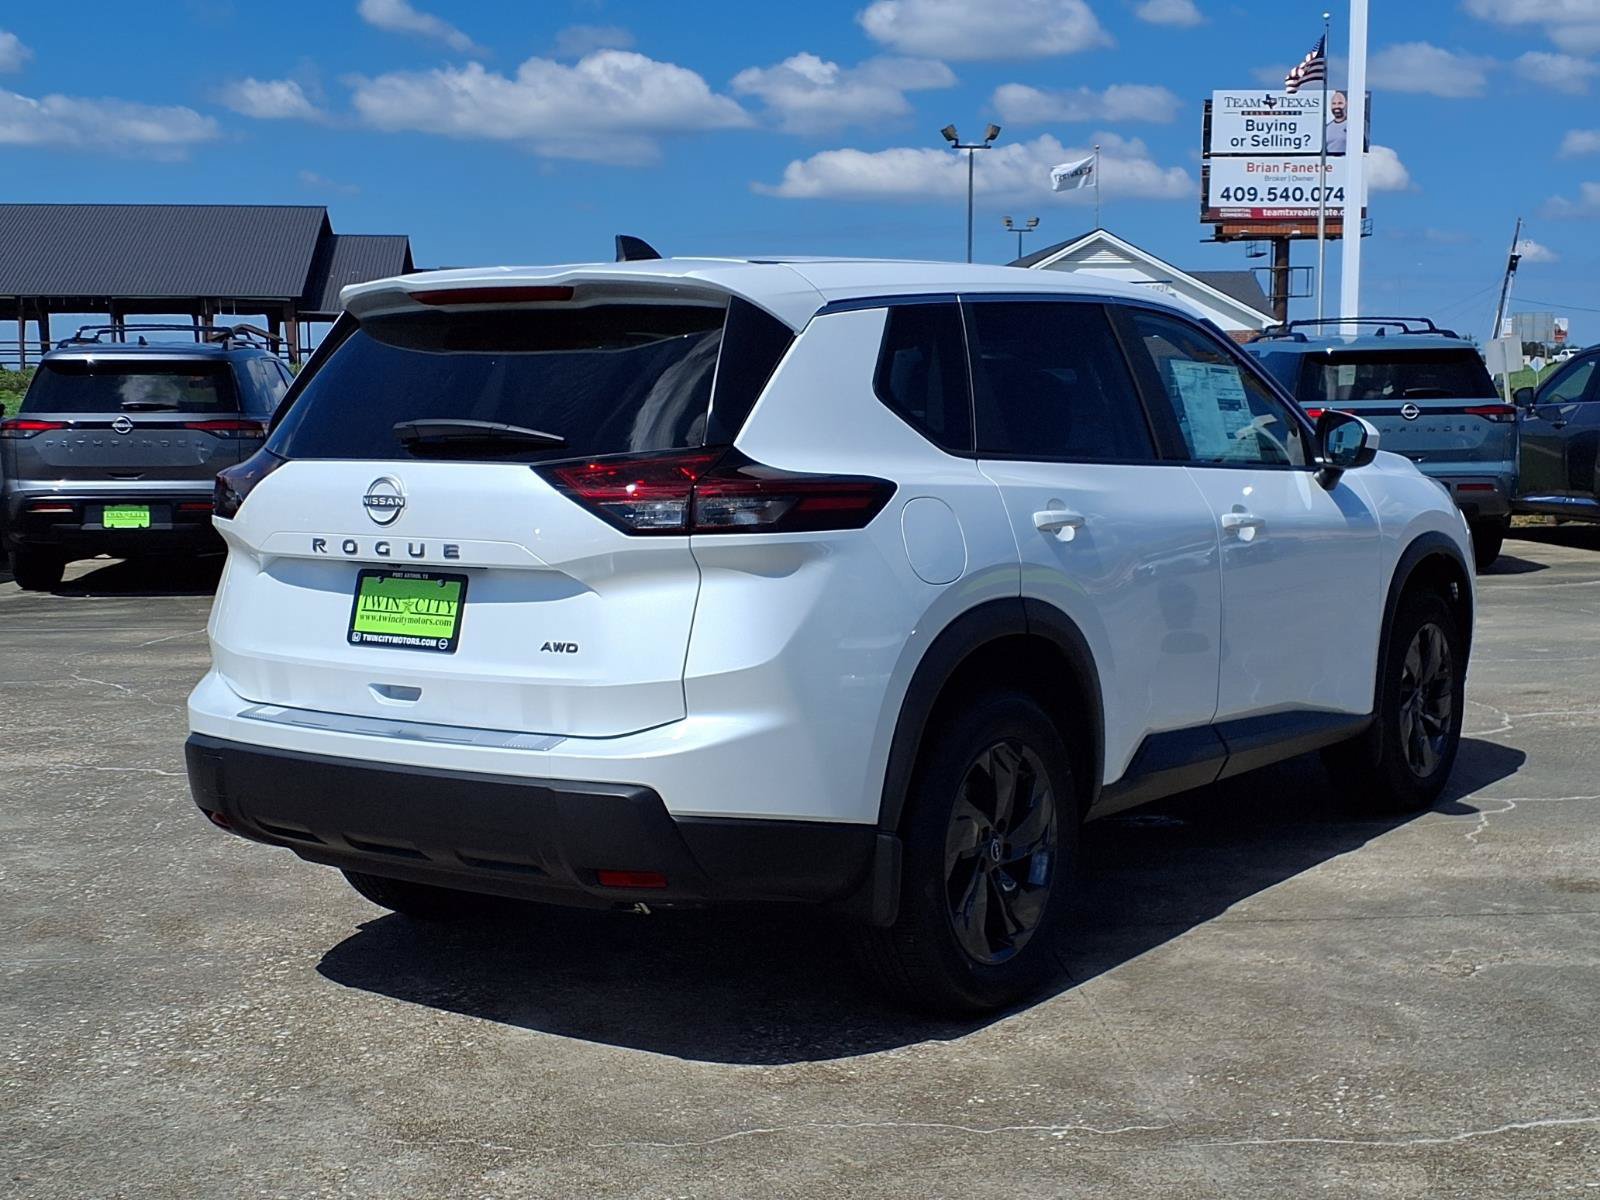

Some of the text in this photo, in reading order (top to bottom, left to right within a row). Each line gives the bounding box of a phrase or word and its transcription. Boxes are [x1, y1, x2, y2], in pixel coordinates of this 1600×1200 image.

[1224, 96, 1320, 108] TEAM TEXAS
[1245, 119, 1298, 135] Buying
[1230, 134, 1312, 150] or Selling?
[1246, 162, 1334, 173] Brian Fanete
[1220, 186, 1345, 202] 409.540.074
[363, 495, 405, 506] NISSAN
[312, 537, 461, 559] ROGUE
[362, 594, 457, 614] TWIN CITY
[360, 613, 453, 627] www.twincitymotors.com
[362, 633, 437, 647] TWINCITYMOTORS.COM
[540, 642, 579, 653] AWD
